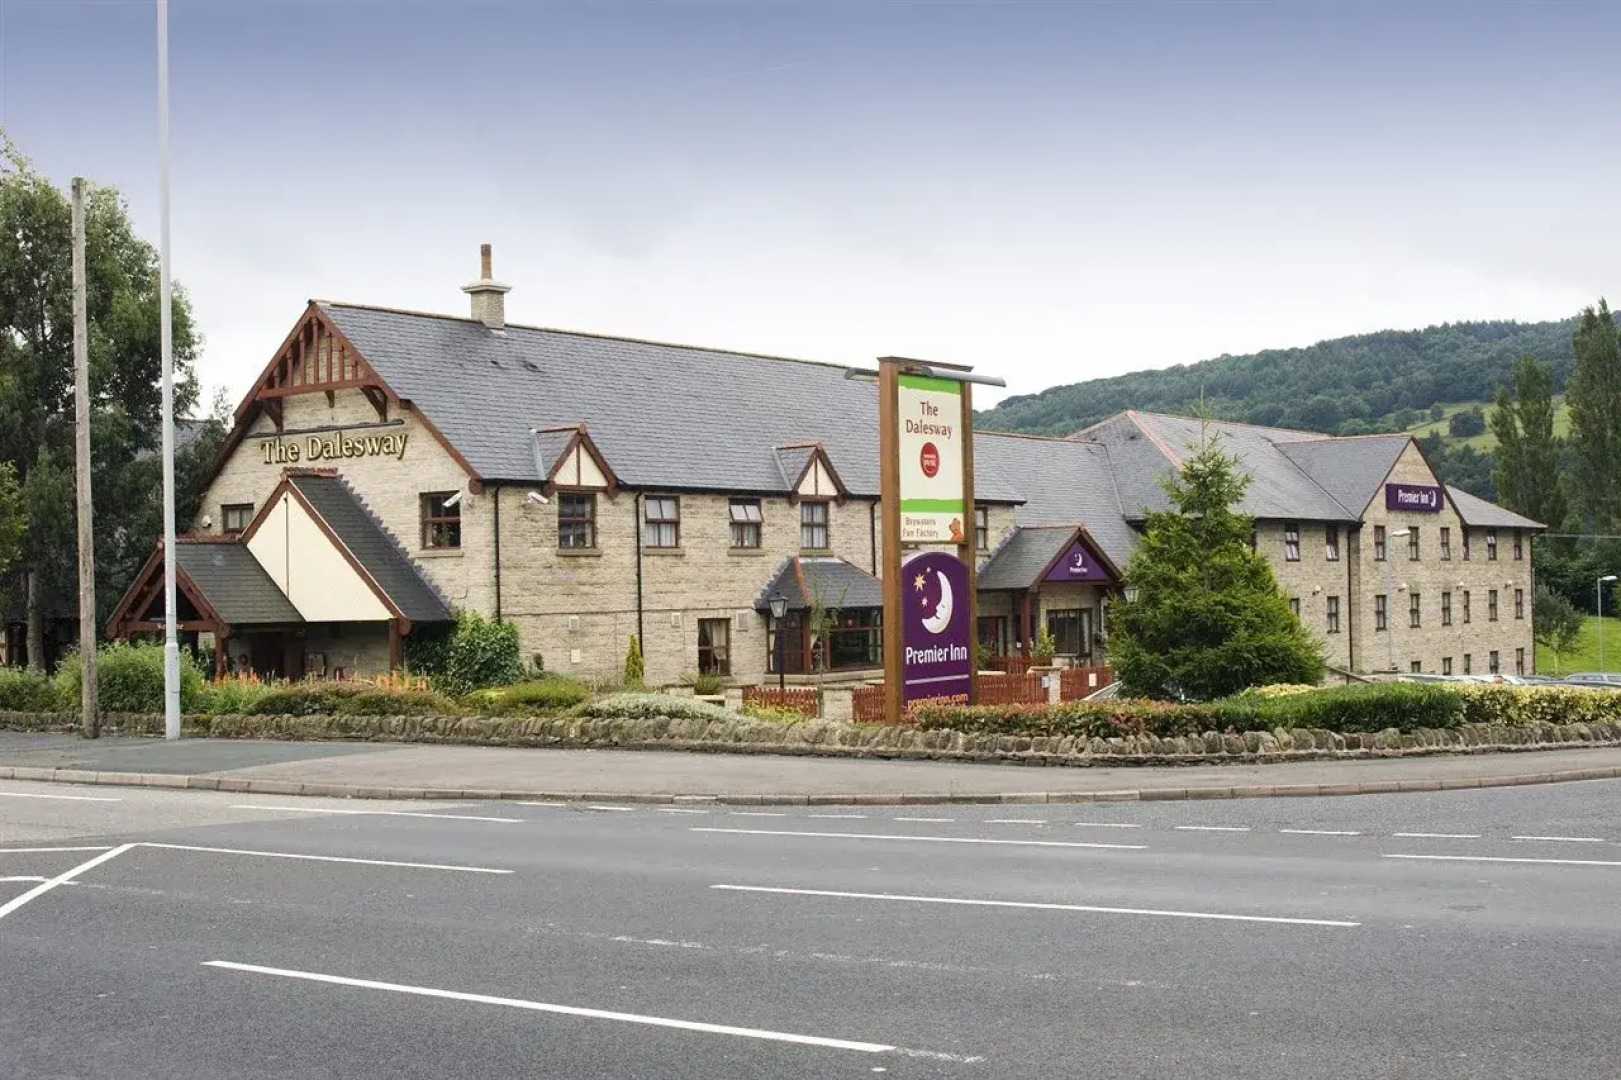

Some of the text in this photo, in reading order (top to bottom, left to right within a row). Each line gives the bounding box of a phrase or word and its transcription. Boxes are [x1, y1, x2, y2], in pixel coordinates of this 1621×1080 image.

[920, 401, 938, 416] The
[905, 419, 952, 439] Dalesway
[261, 431, 408, 464] The Dalesway
[905, 643, 967, 665] Premier Inn
